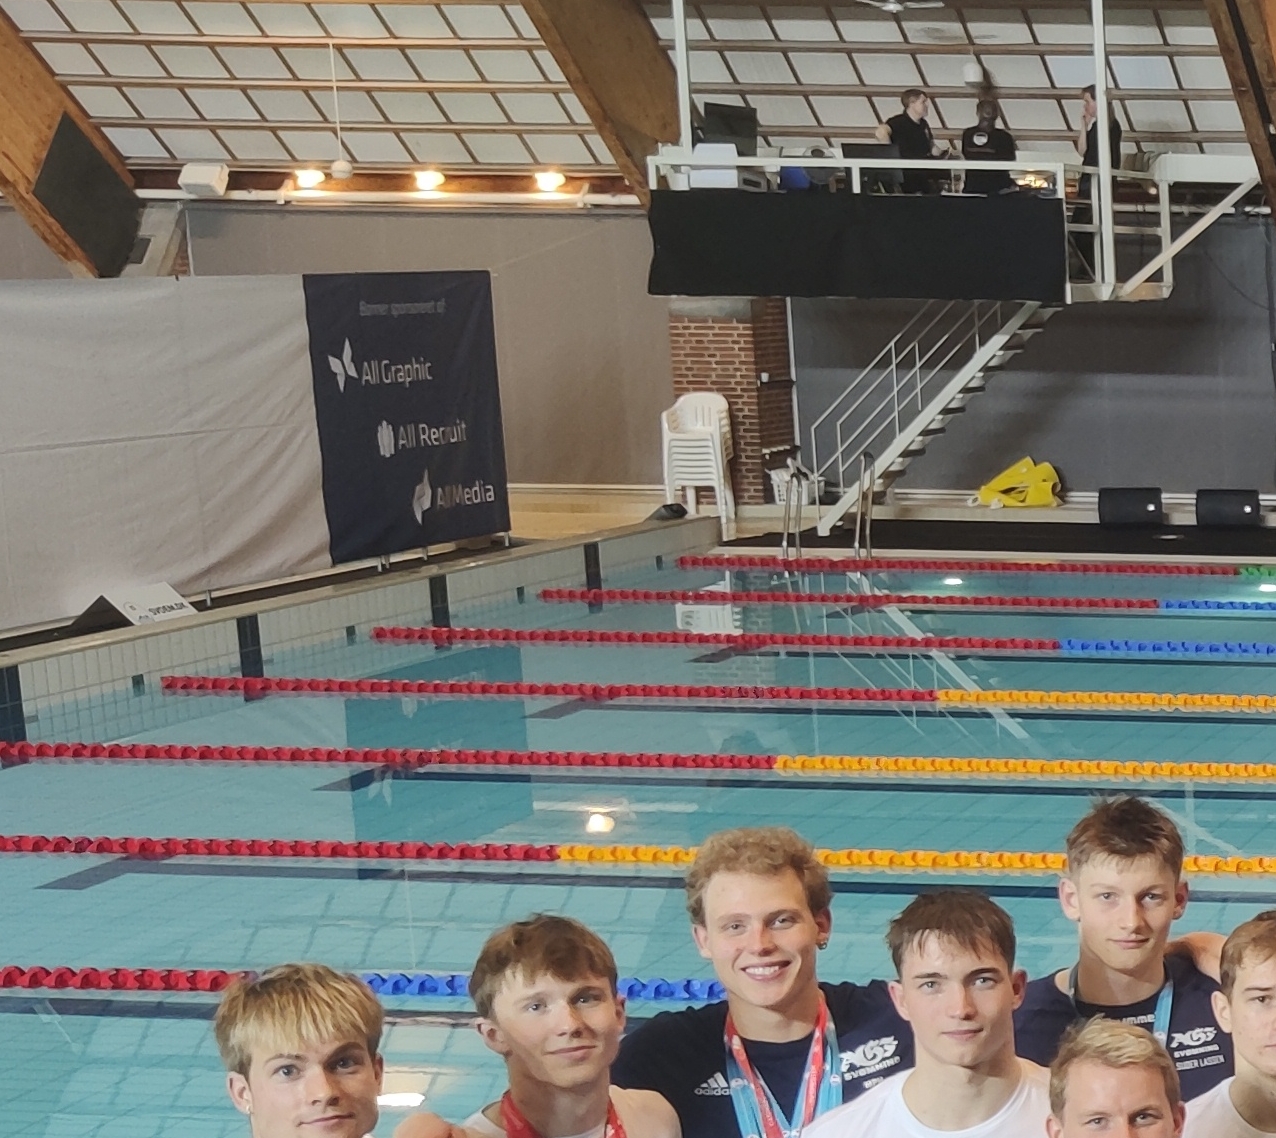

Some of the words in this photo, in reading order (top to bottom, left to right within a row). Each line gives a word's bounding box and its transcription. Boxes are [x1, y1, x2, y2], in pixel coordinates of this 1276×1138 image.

[380, 356, 433, 387] Graphic
[398, 424, 416, 449] All
[694, 1087, 732, 1096] adida
